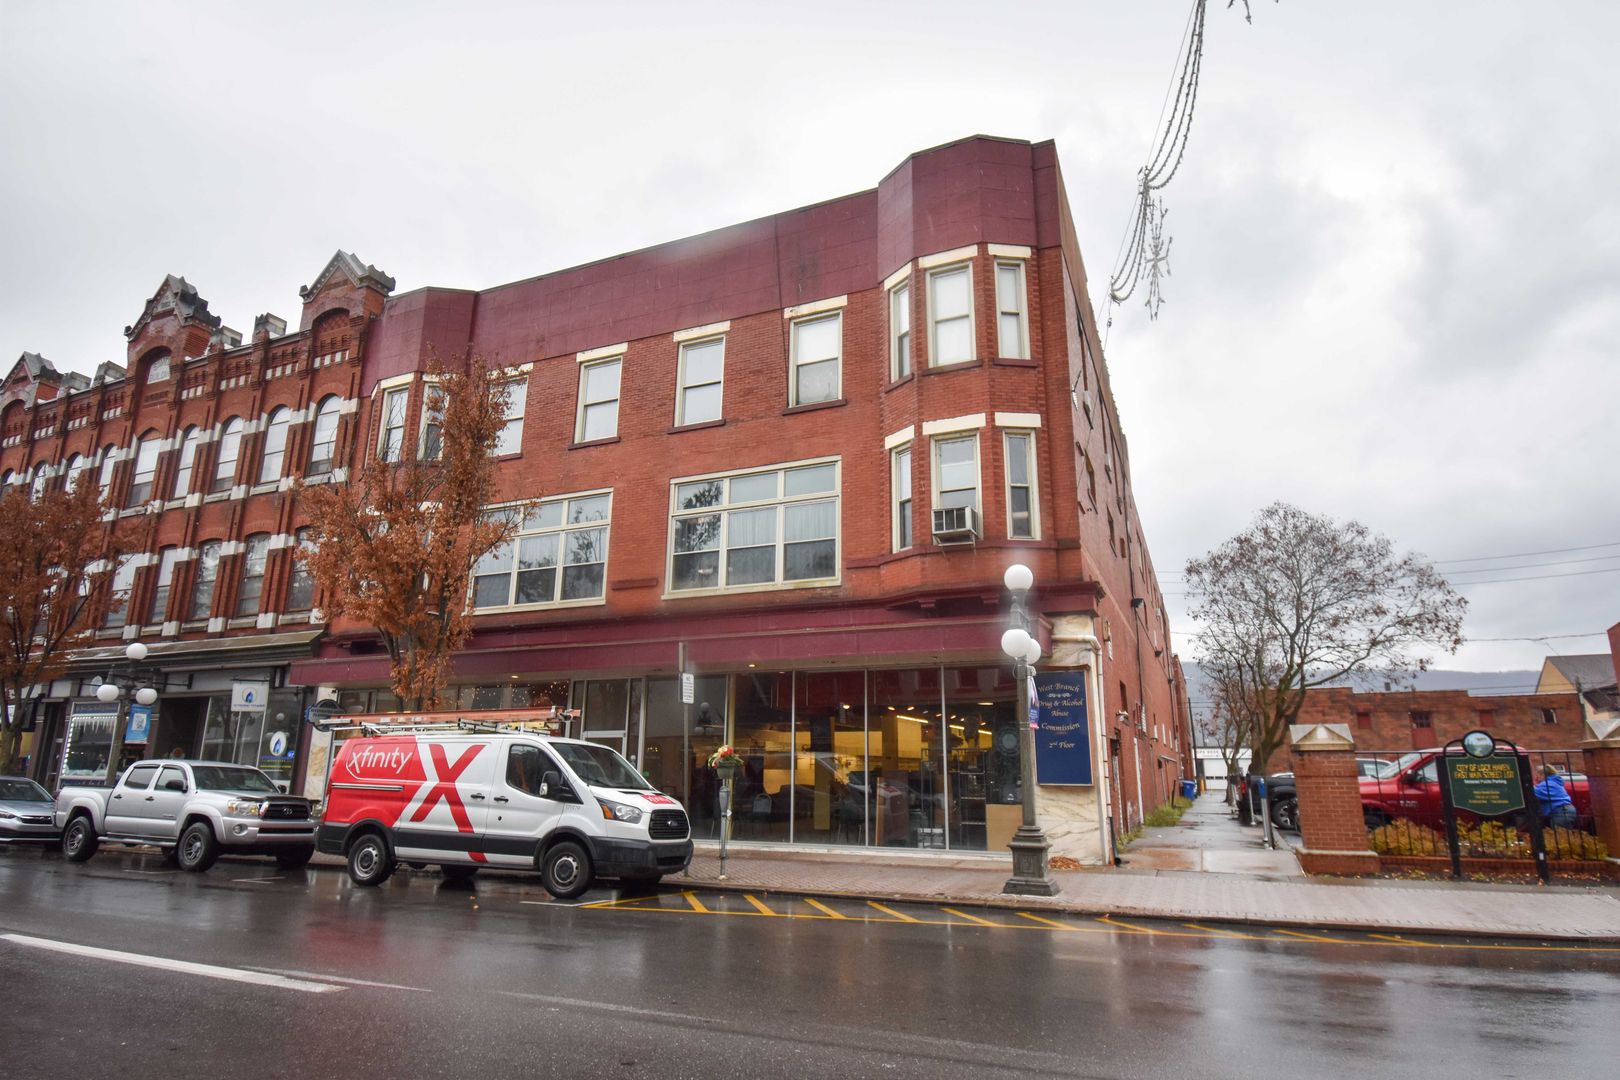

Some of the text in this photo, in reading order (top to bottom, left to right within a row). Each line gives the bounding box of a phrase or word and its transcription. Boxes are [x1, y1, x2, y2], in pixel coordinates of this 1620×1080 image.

[1055, 683, 1080, 692] Branch
[1039, 701, 1053, 709] Drug
[1041, 722, 1081, 731] Commission
[1059, 741, 1076, 749] Floor
[348, 745, 413, 774] xfinity
[1456, 764, 1469, 772] CITY
